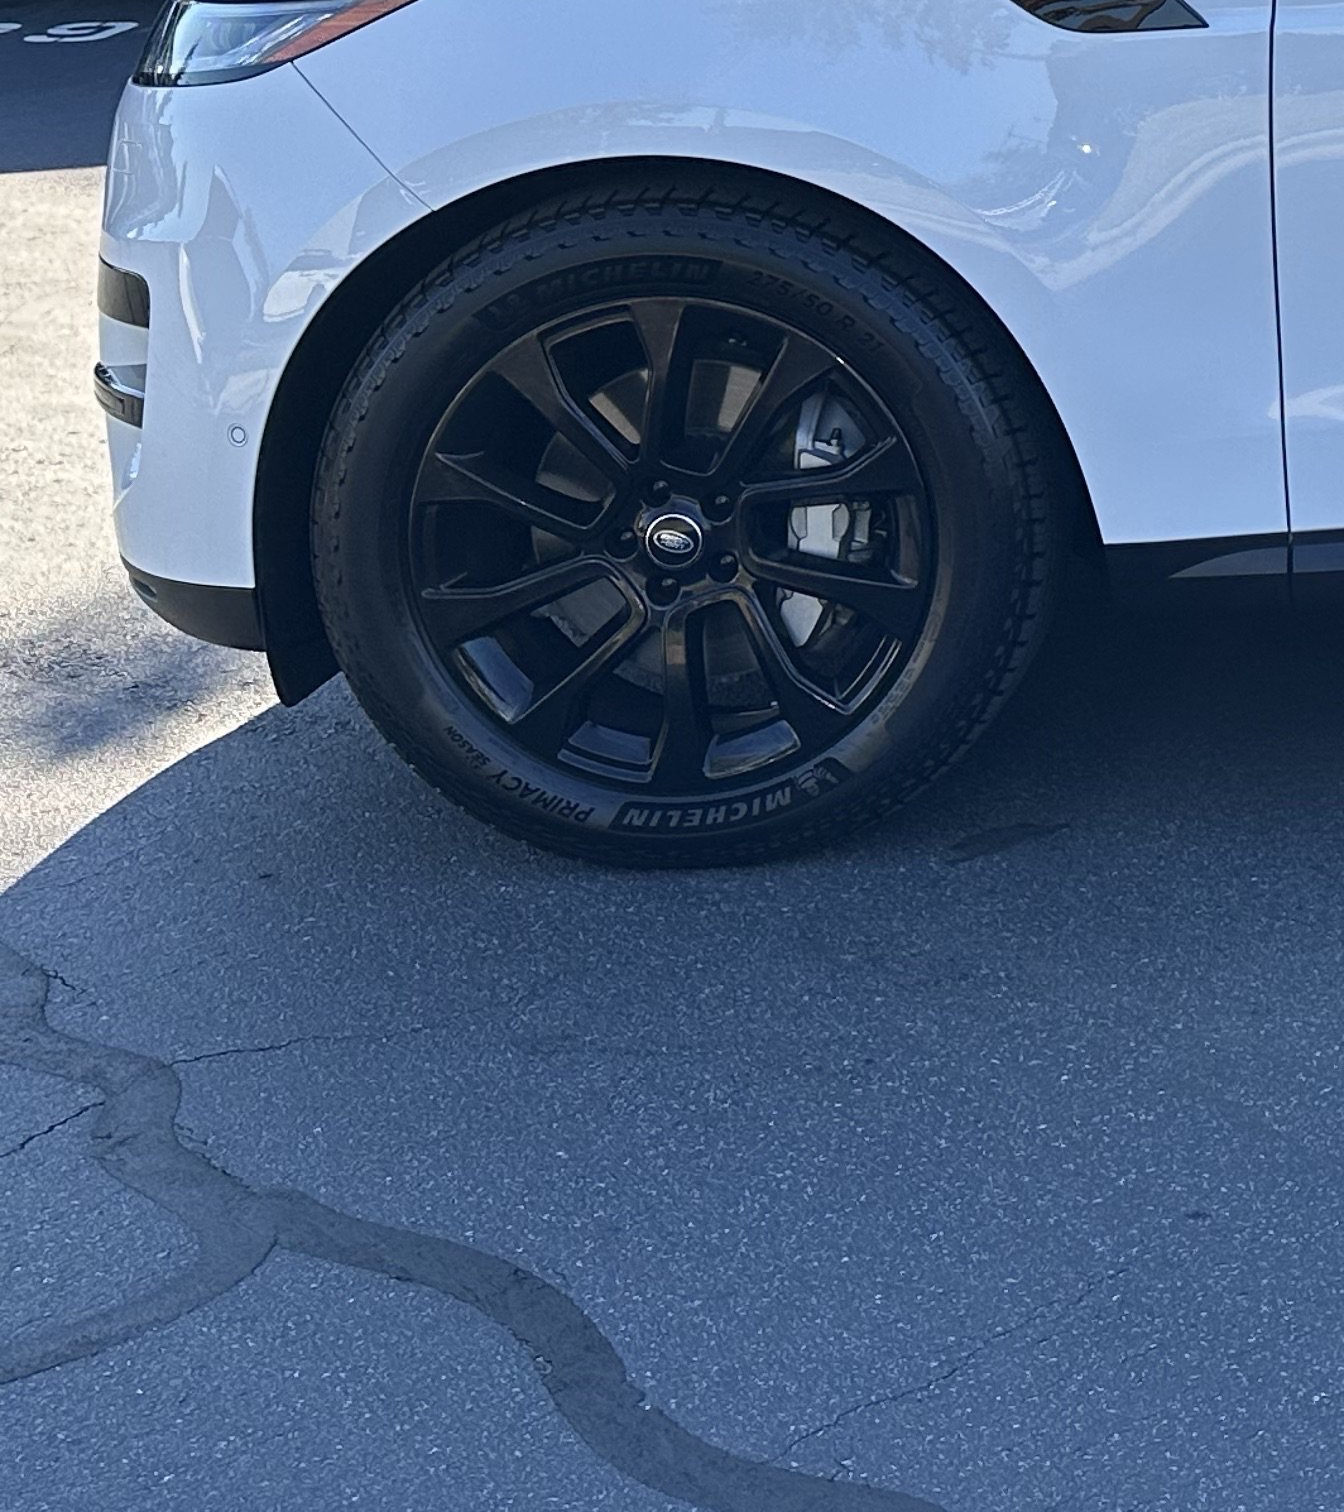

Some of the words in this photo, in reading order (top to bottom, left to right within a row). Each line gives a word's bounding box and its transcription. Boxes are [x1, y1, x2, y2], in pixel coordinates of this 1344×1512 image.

[536, 261, 712, 300] MICHELIN
[443, 725, 491, 767] SEASON
[487, 770, 595, 823] PRIMACY
[623, 787, 792, 827] MICHELIN
